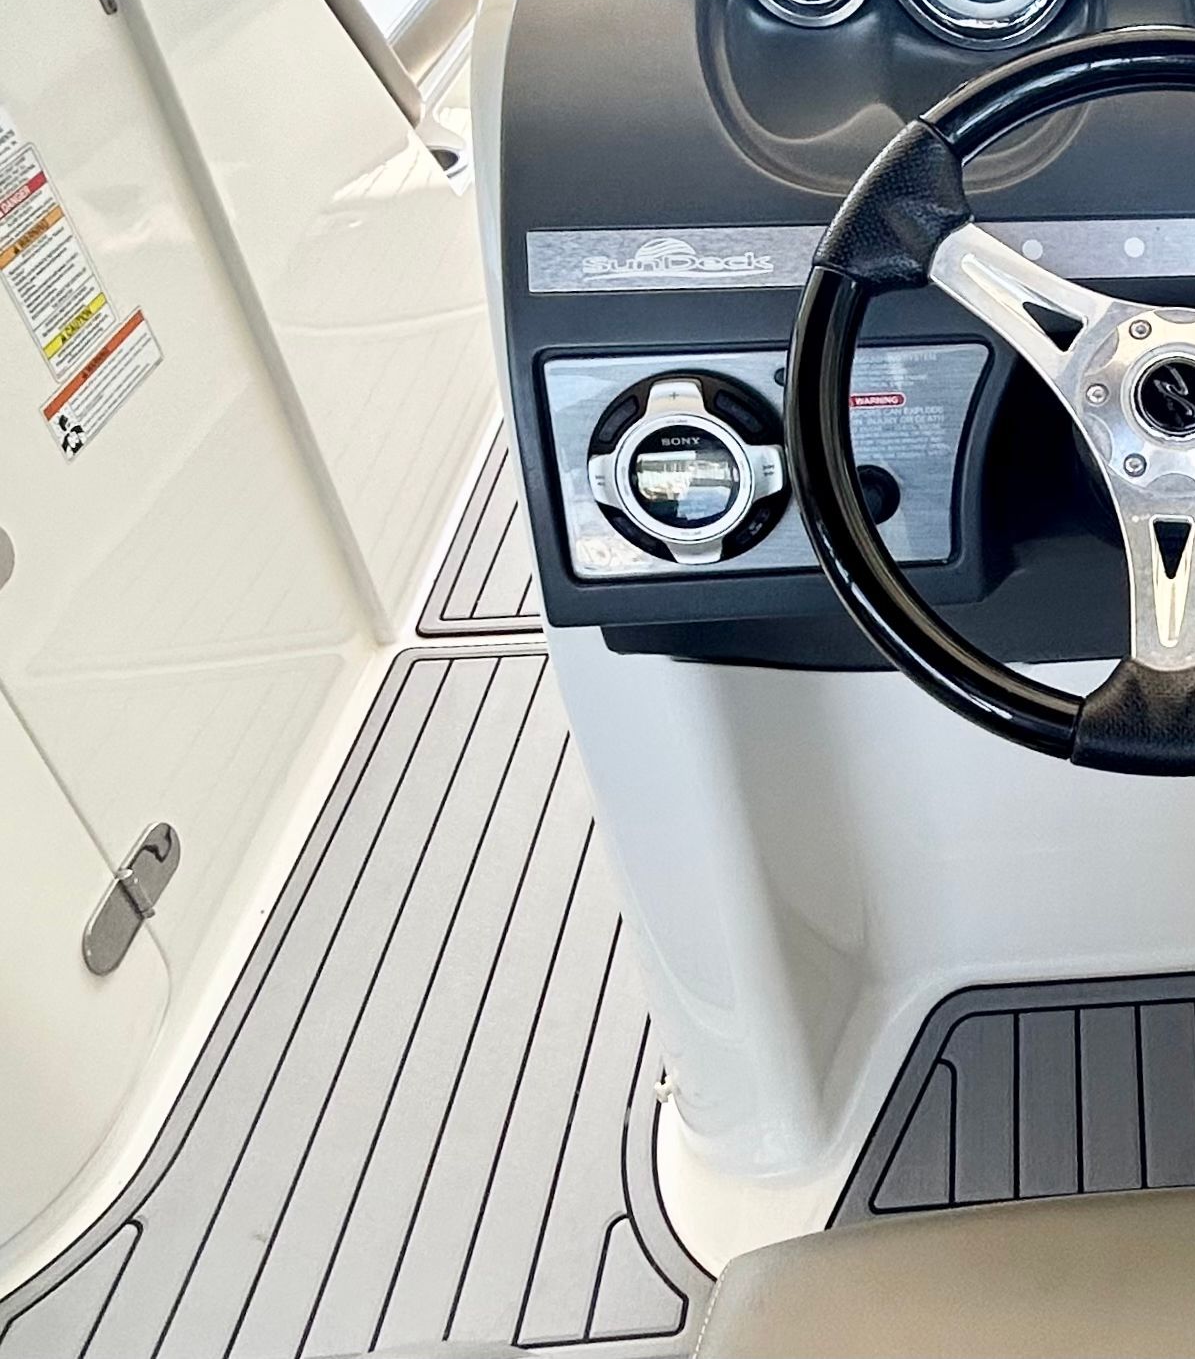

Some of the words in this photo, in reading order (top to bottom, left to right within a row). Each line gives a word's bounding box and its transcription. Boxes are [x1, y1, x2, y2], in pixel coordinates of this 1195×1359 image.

[1, 184, 31, 214] DANGER
[582, 251, 775, 274] SunDeck
[63, 306, 93, 337] CAUTION
[855, 395, 899, 405] WARNING
[661, 437, 700, 446] SONY
